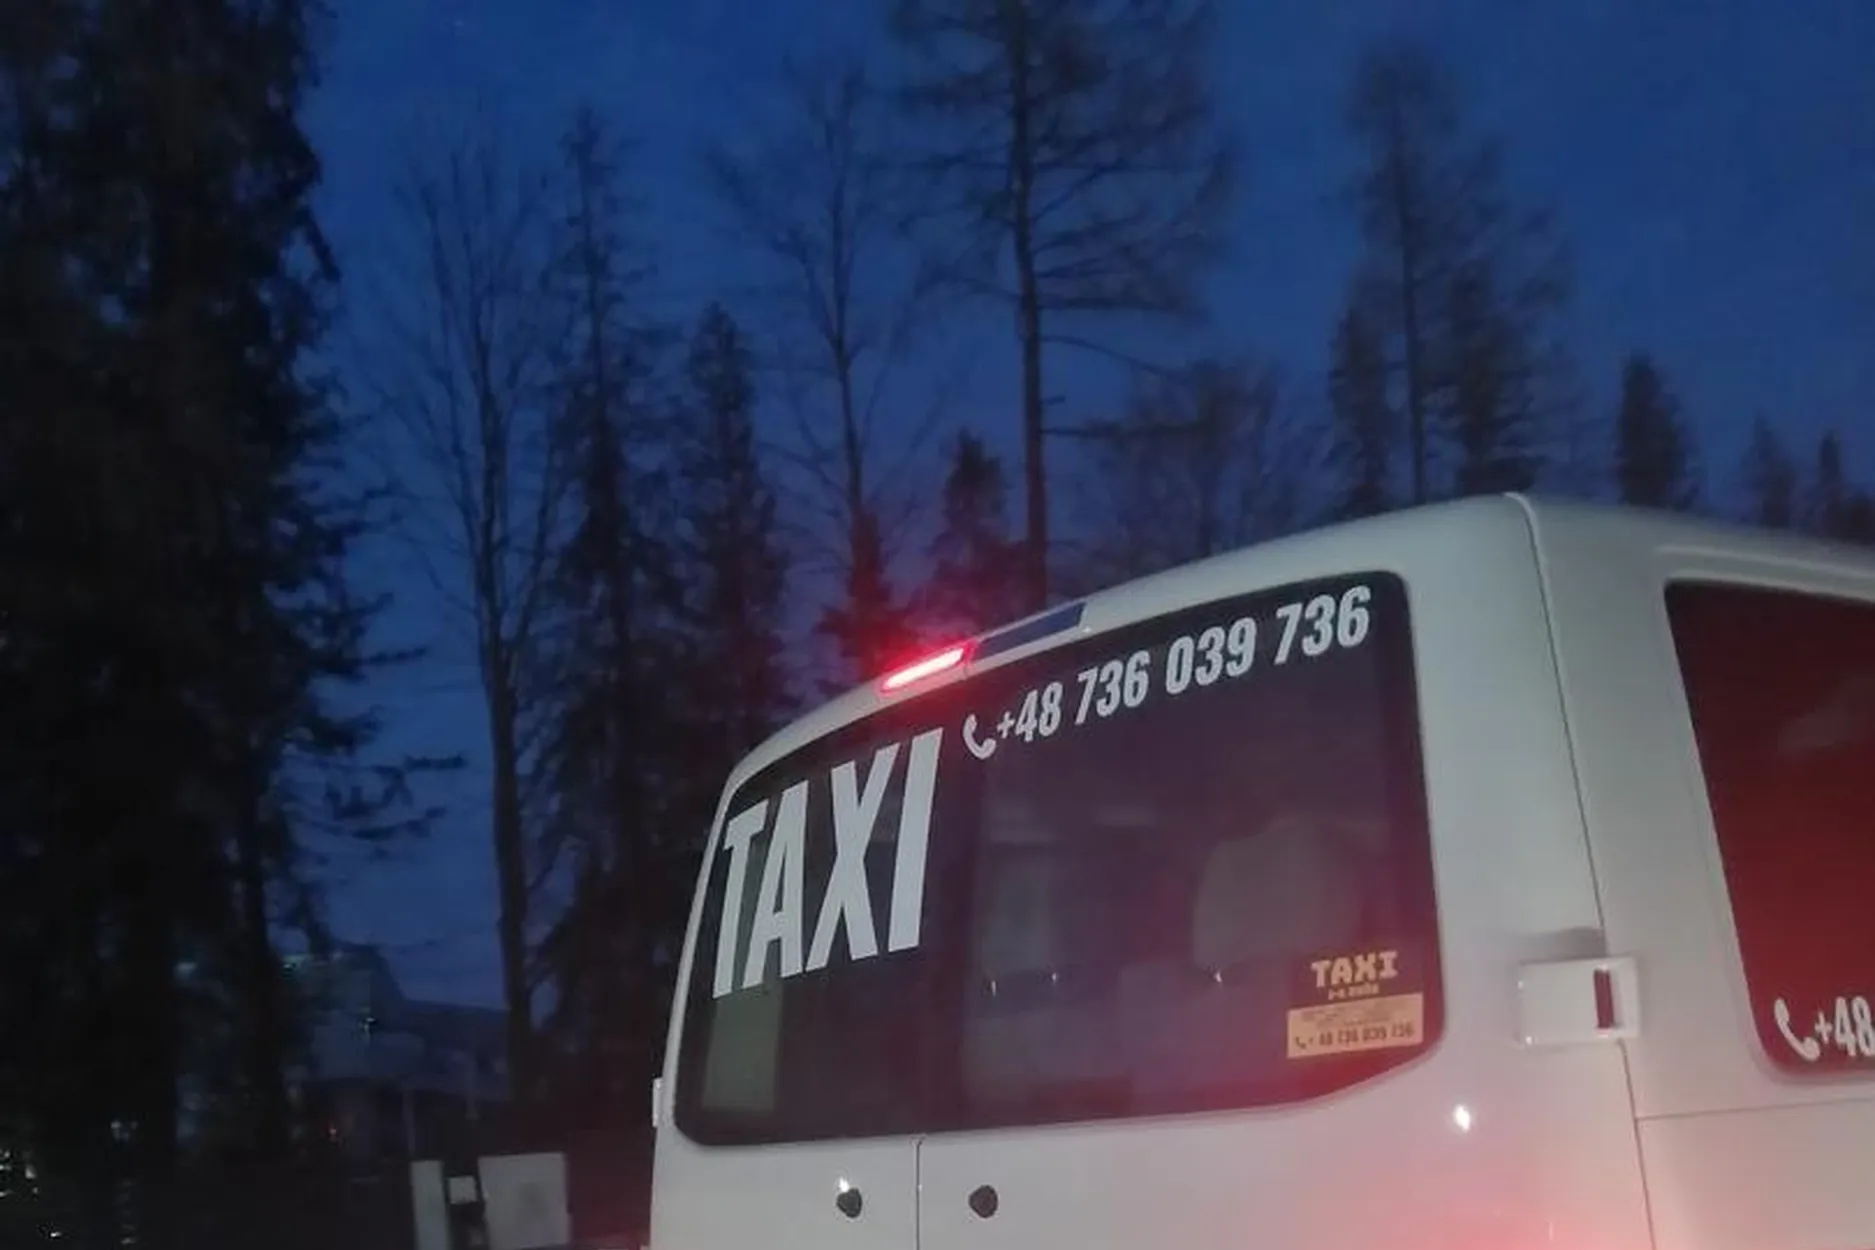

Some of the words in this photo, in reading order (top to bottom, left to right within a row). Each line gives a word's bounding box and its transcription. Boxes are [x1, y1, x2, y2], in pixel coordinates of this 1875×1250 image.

[997, 681, 1062, 742] +48
[1074, 650, 1151, 725] 736
[1165, 616, 1256, 695] 039
[1273, 585, 1371, 665] 736
[712, 727, 943, 999] TAXI
[1311, 951, 1398, 988] TAXI
[1814, 996, 1875, 1057] +48
